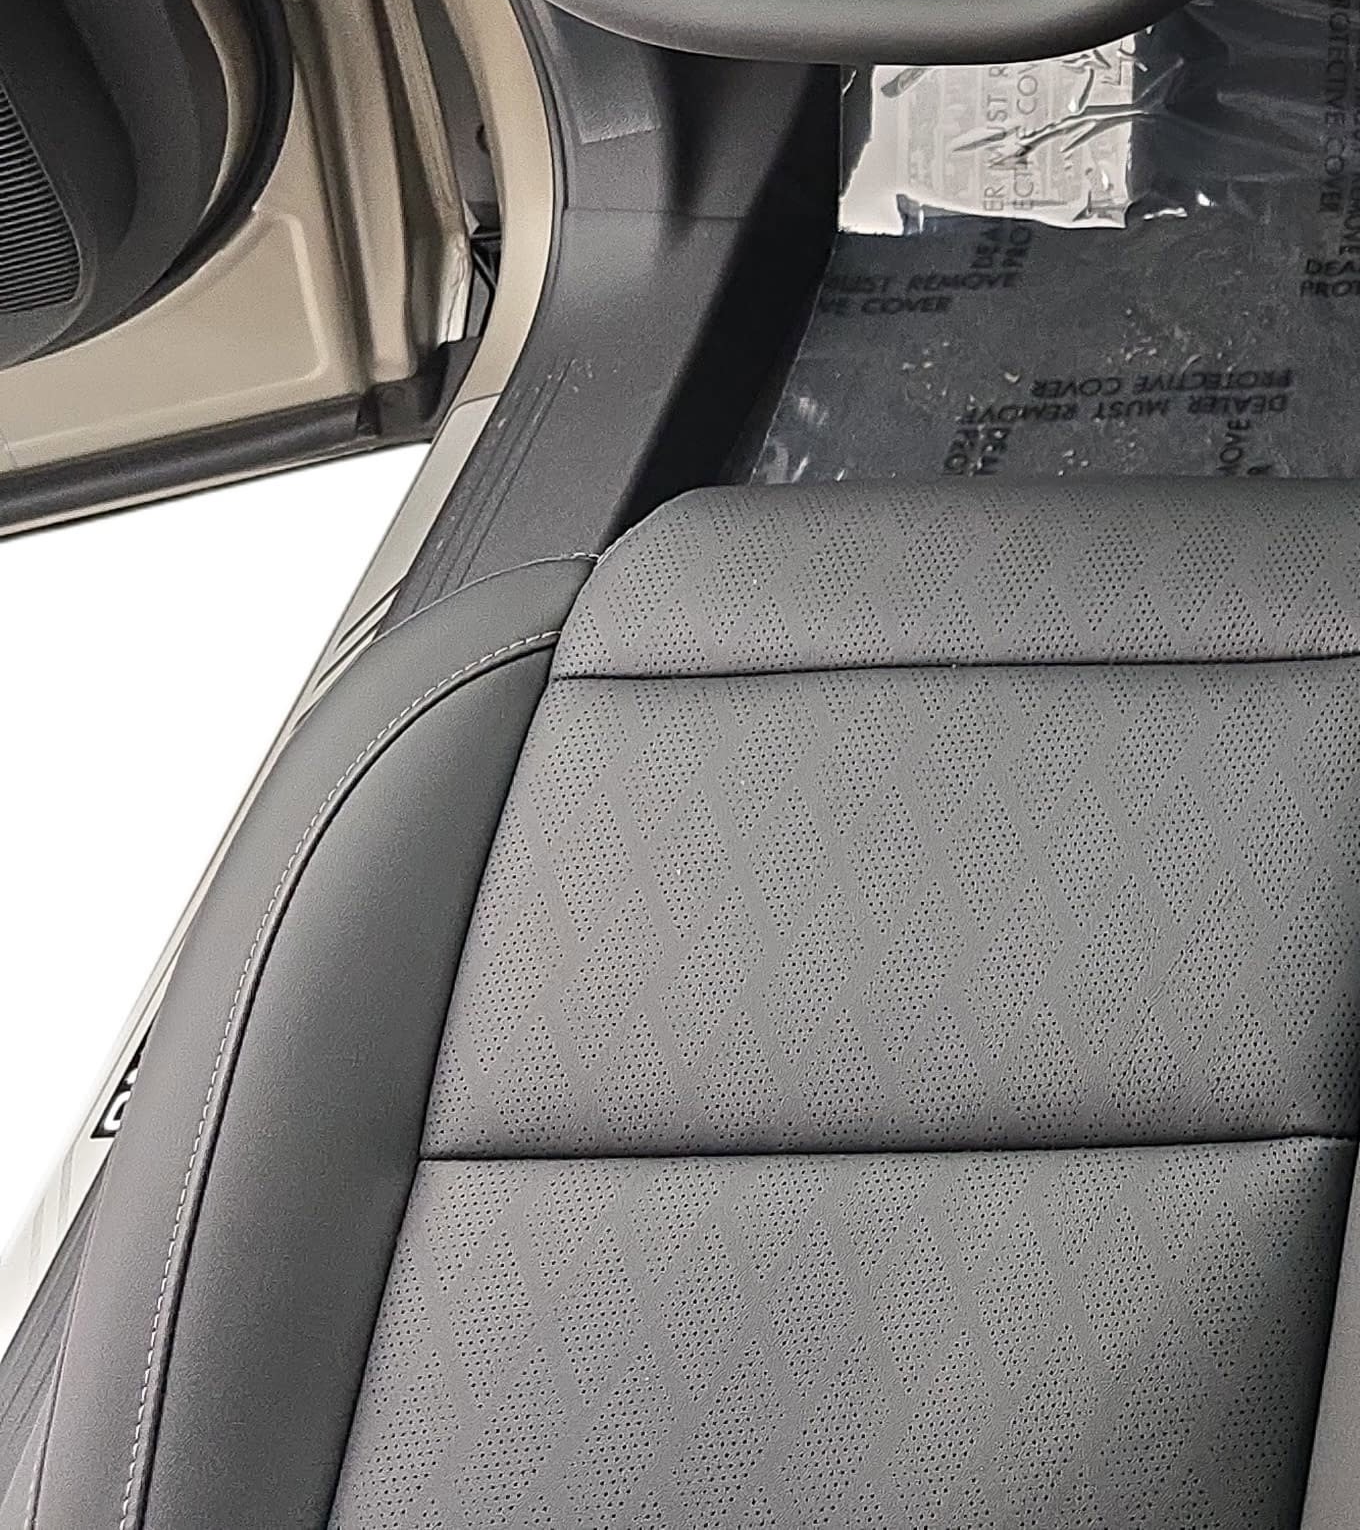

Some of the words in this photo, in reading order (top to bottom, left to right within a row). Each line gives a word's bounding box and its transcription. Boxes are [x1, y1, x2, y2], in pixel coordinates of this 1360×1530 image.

[1029, 376, 1122, 399] COVER
[1135, 369, 1295, 394] PROTECTIVE
[1090, 399, 1170, 421] MUST
[1186, 393, 1290, 415] DEALER
